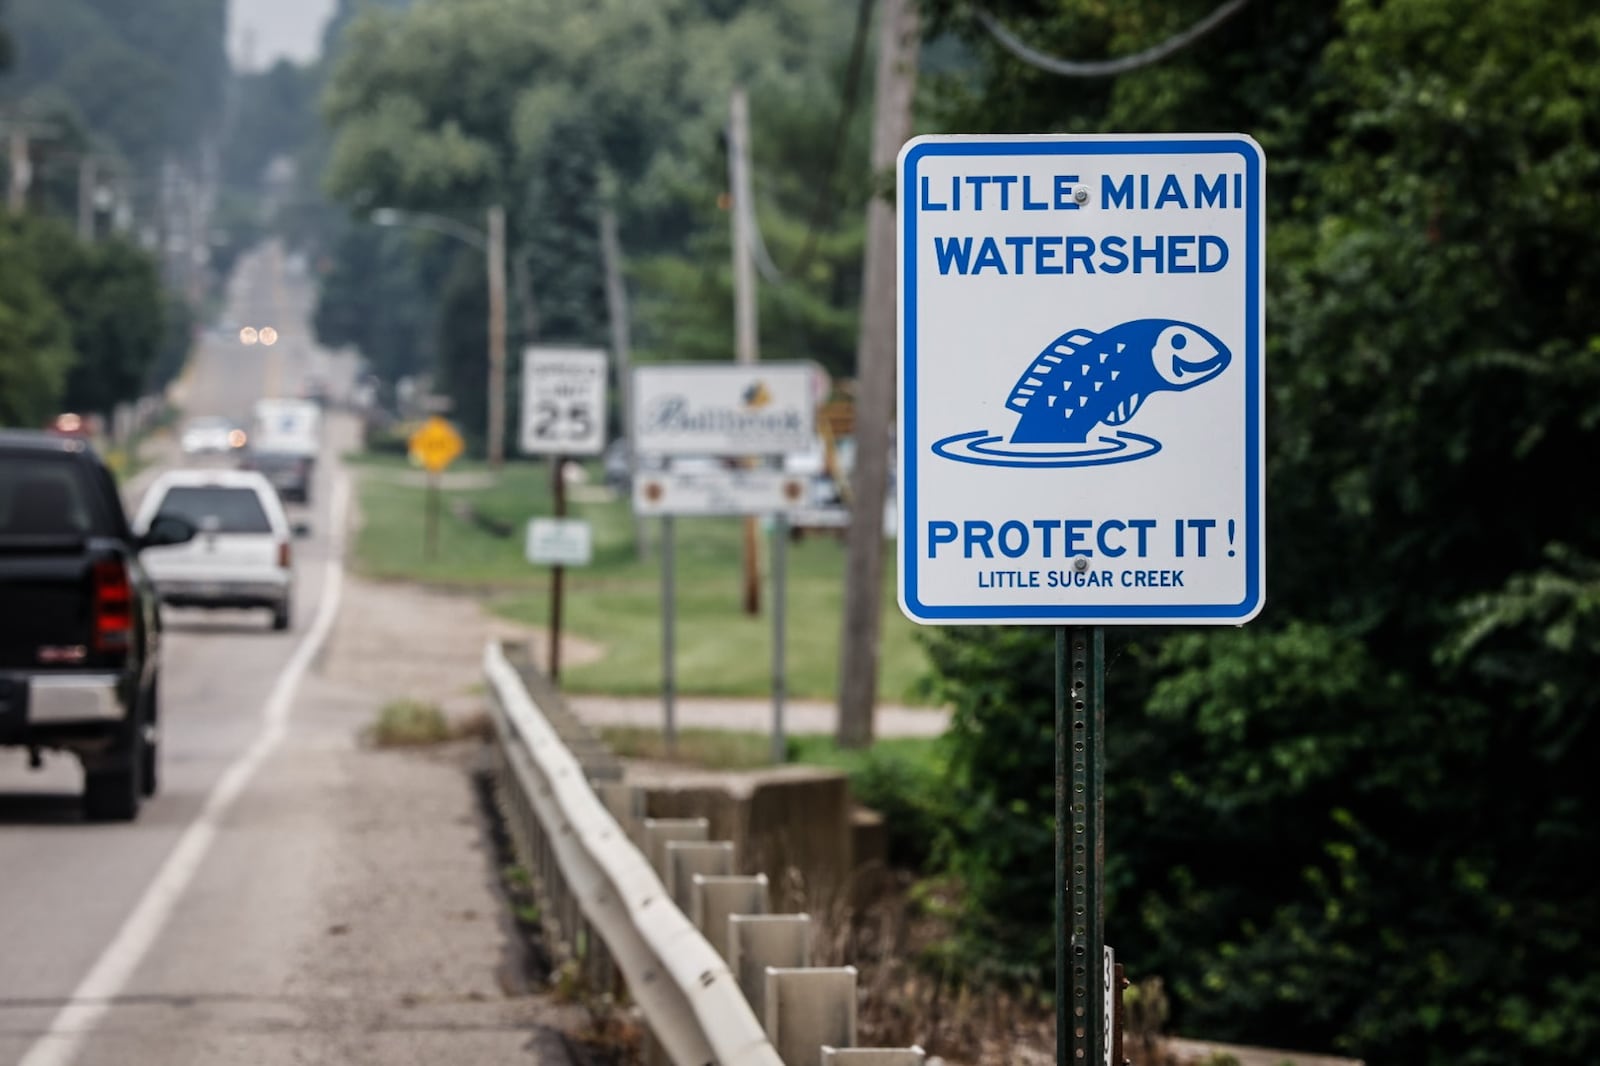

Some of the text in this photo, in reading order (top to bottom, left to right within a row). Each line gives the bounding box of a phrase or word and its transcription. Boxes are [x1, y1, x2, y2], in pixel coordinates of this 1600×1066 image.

[920, 173, 1243, 212] LITTLE MIAMI
[933, 235, 1231, 276] WATERSHED
[533, 402, 595, 441] 25
[927, 518, 1157, 559] PROTECT
[978, 569, 1185, 589] LITTLE SUGAR CREEK
